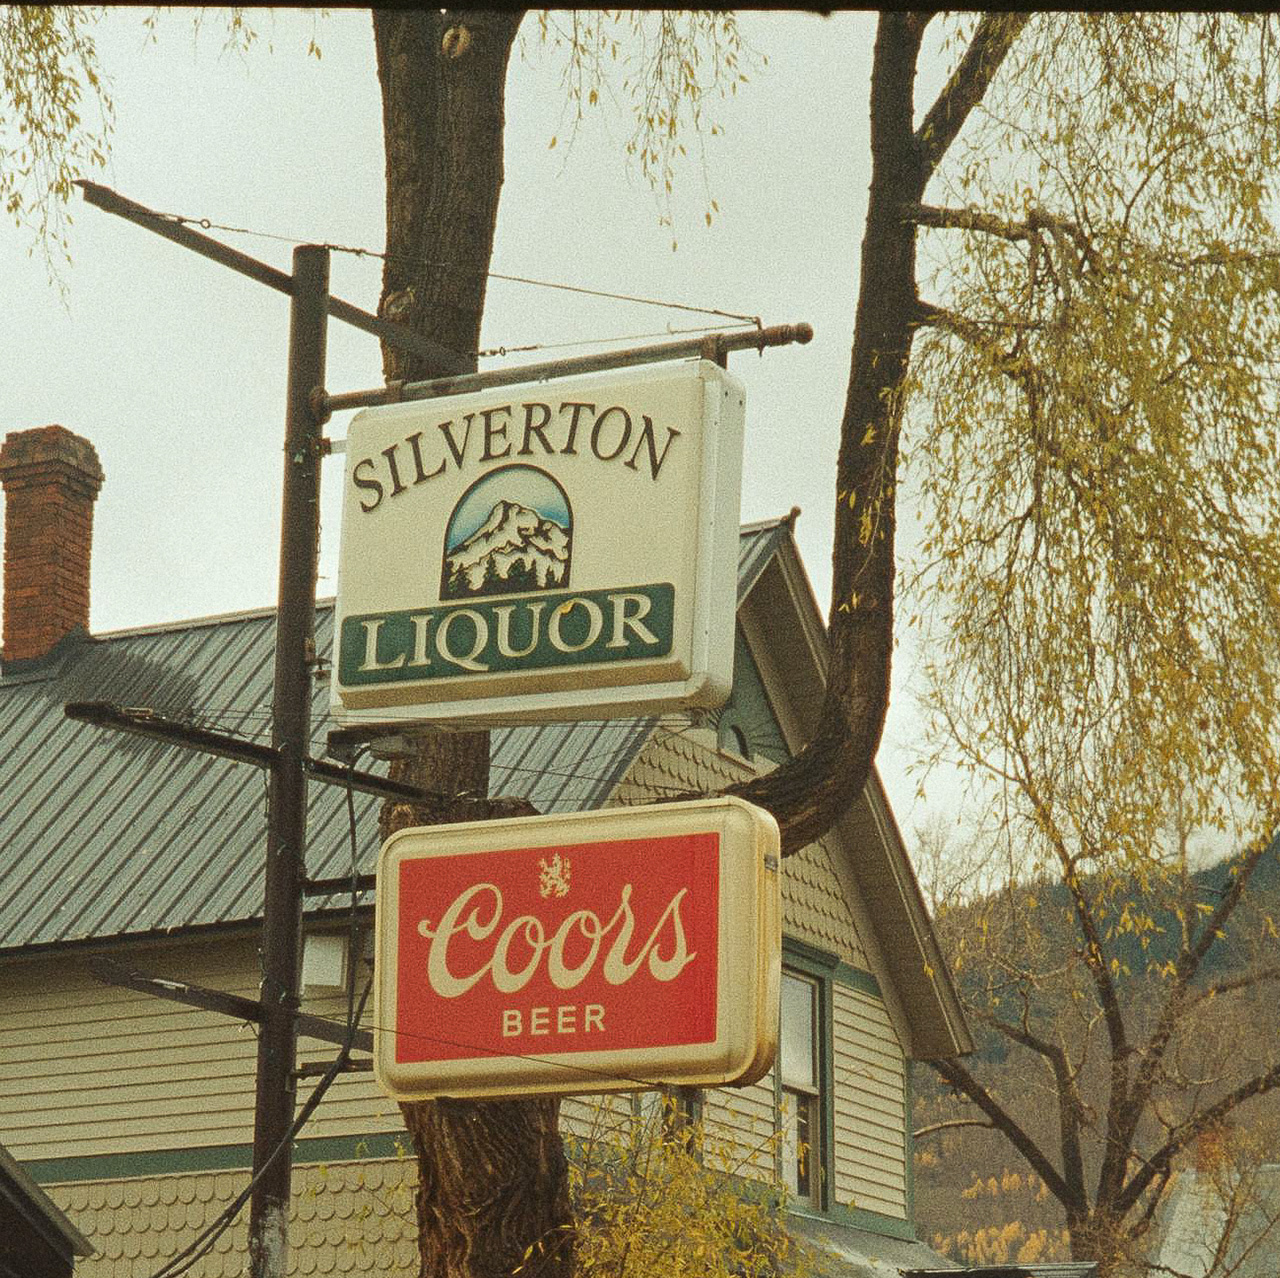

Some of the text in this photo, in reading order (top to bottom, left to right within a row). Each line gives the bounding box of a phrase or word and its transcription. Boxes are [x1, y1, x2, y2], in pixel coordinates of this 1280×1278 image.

[352, 401, 681, 514] SILVERTON
[358, 592, 659, 674] LIQUOR
[417, 881, 699, 999] Coors
[501, 1004, 606, 1038] BEER
